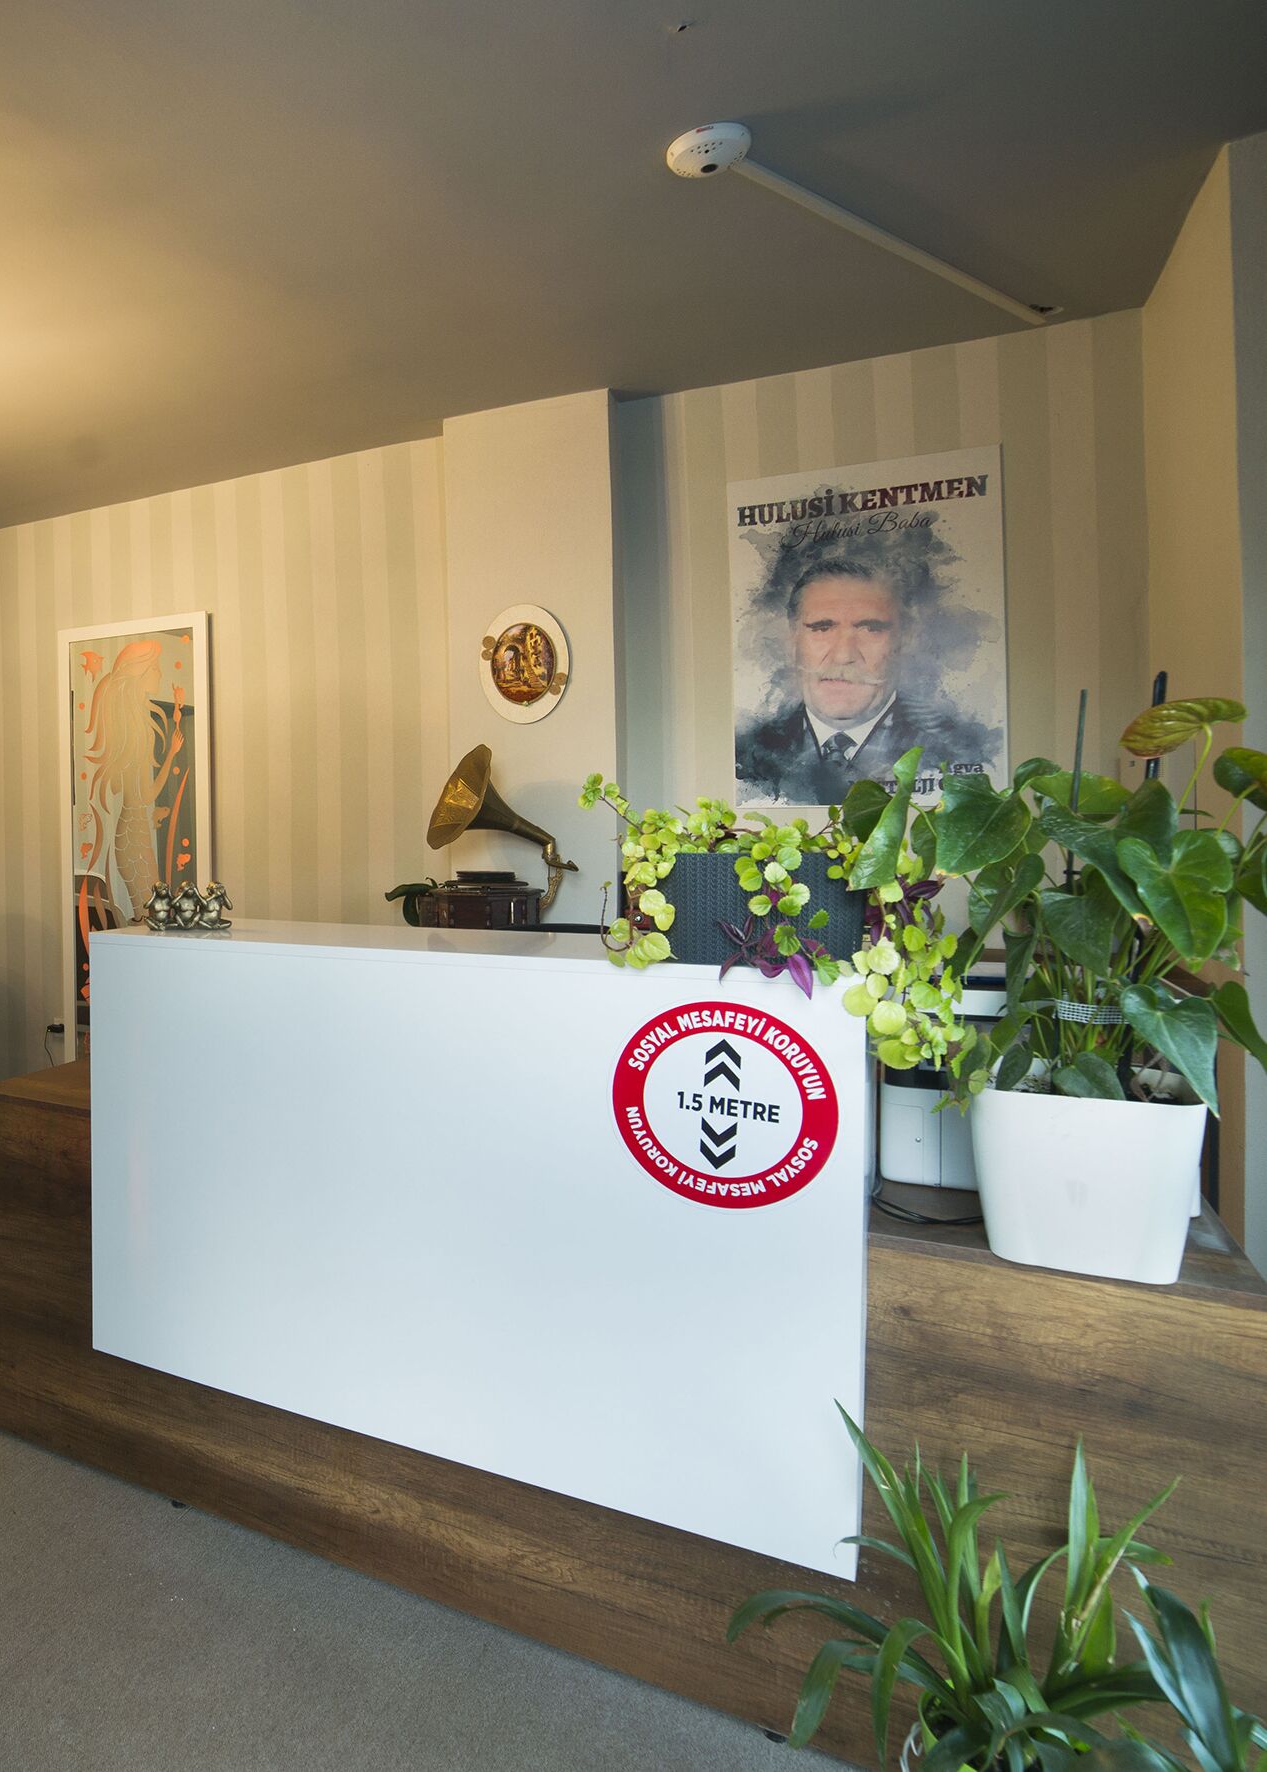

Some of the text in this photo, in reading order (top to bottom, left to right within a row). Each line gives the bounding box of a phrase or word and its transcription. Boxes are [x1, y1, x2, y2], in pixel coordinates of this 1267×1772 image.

[737, 474, 989, 528] HULUSİ KENTMEN
[780, 511, 933, 549] Hulusi Baba
[628, 1009, 827, 1101] SOSYAL MESAFEYİ KORUYUN
[677, 1091, 781, 1124] 1.5 METRE
[625, 1106, 819, 1197] SOSYAL MESAFEYİ KORUYUN
